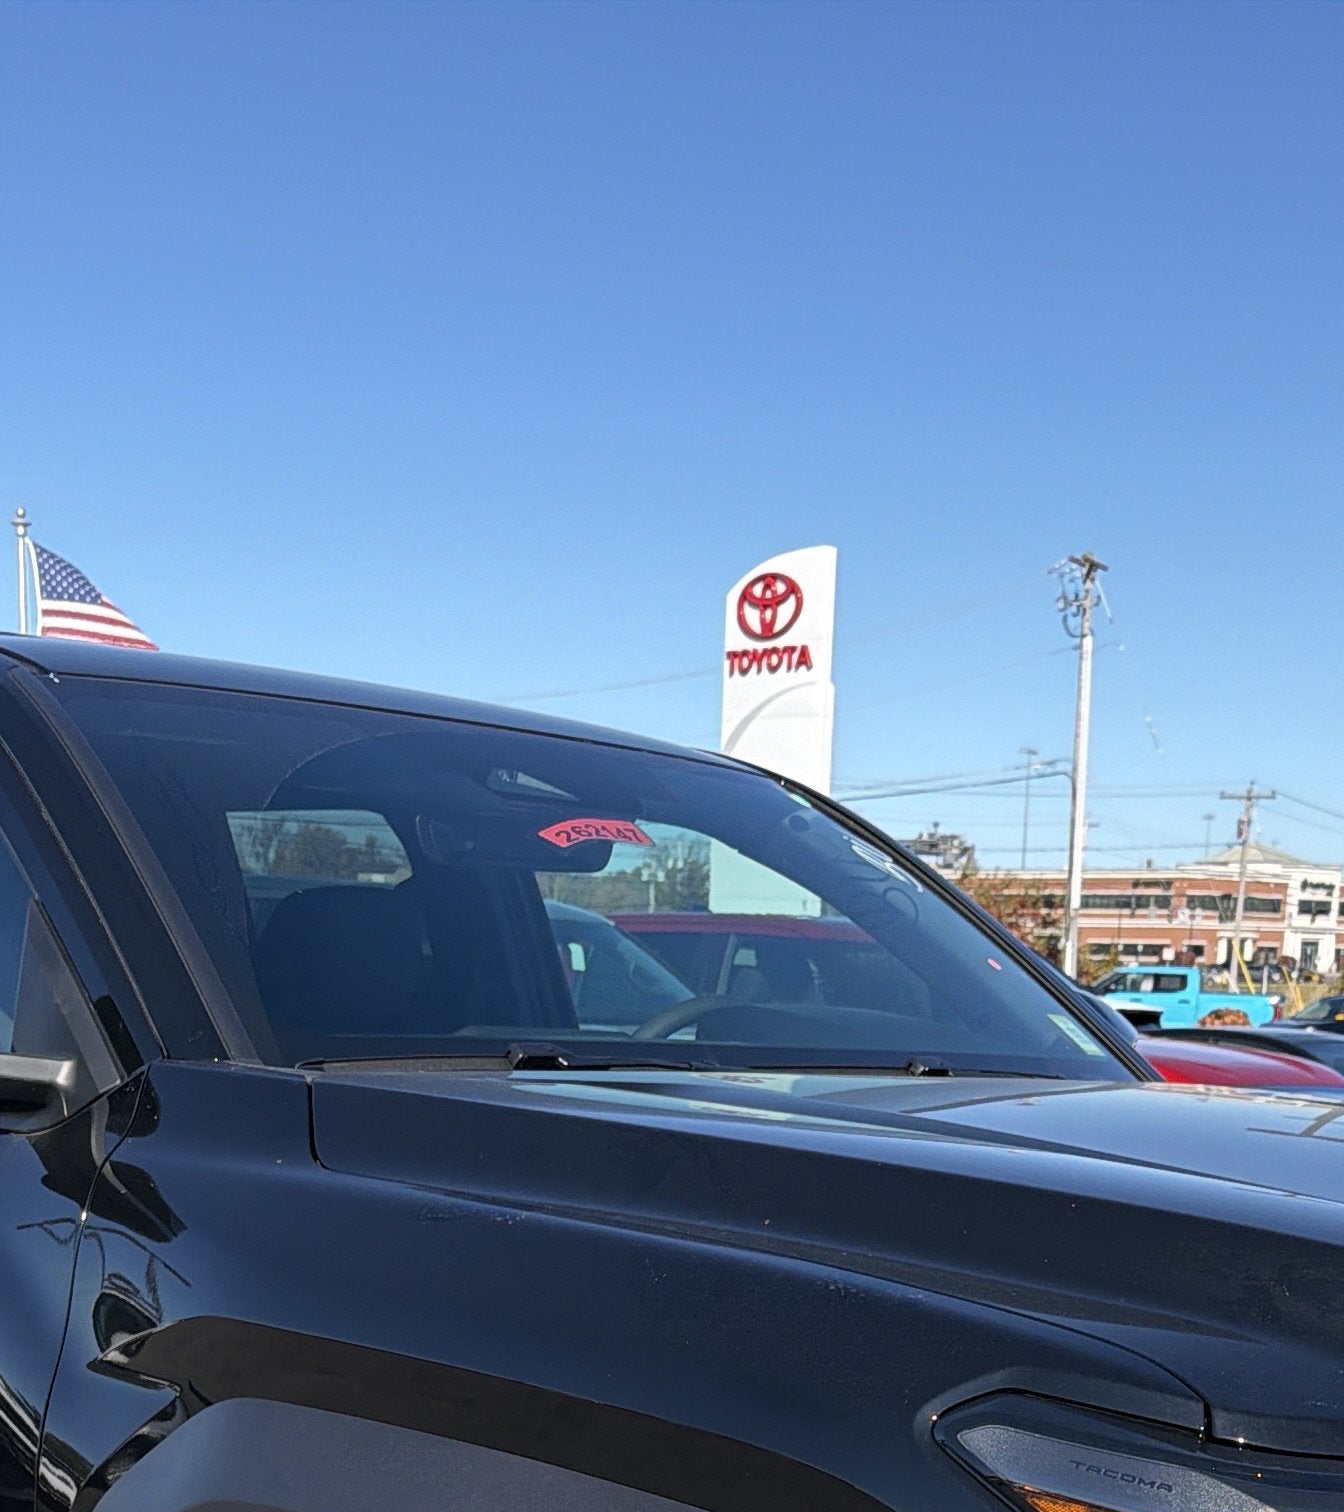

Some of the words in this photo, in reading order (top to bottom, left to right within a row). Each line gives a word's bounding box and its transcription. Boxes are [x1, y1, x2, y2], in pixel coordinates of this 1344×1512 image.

[726, 645, 813, 678] TOYOTA
[554, 824, 643, 843] 262147
[1070, 1460, 1173, 1492] TACOMA
